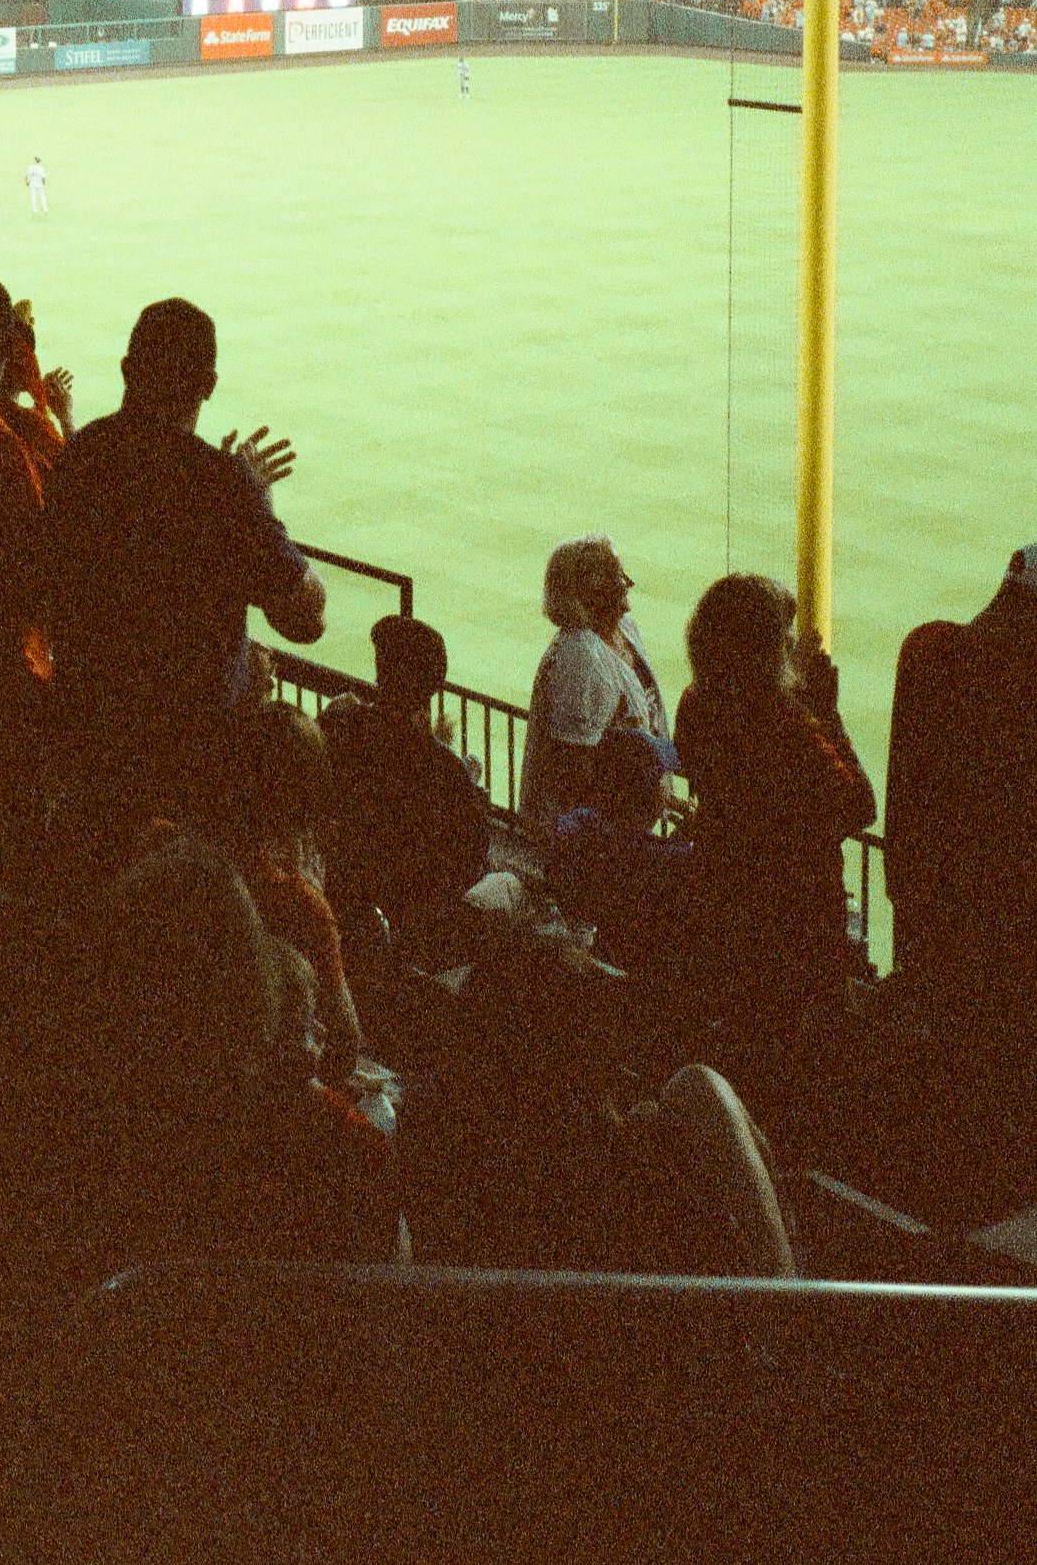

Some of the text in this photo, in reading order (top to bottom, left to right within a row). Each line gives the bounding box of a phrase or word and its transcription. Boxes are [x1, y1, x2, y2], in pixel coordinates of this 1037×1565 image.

[386, 15, 452, 36] EQUIFAX
[499, 10, 528, 23] Mercy
[289, 19, 359, 45] PERFICIENT
[65, 49, 103, 67] STIFEL
